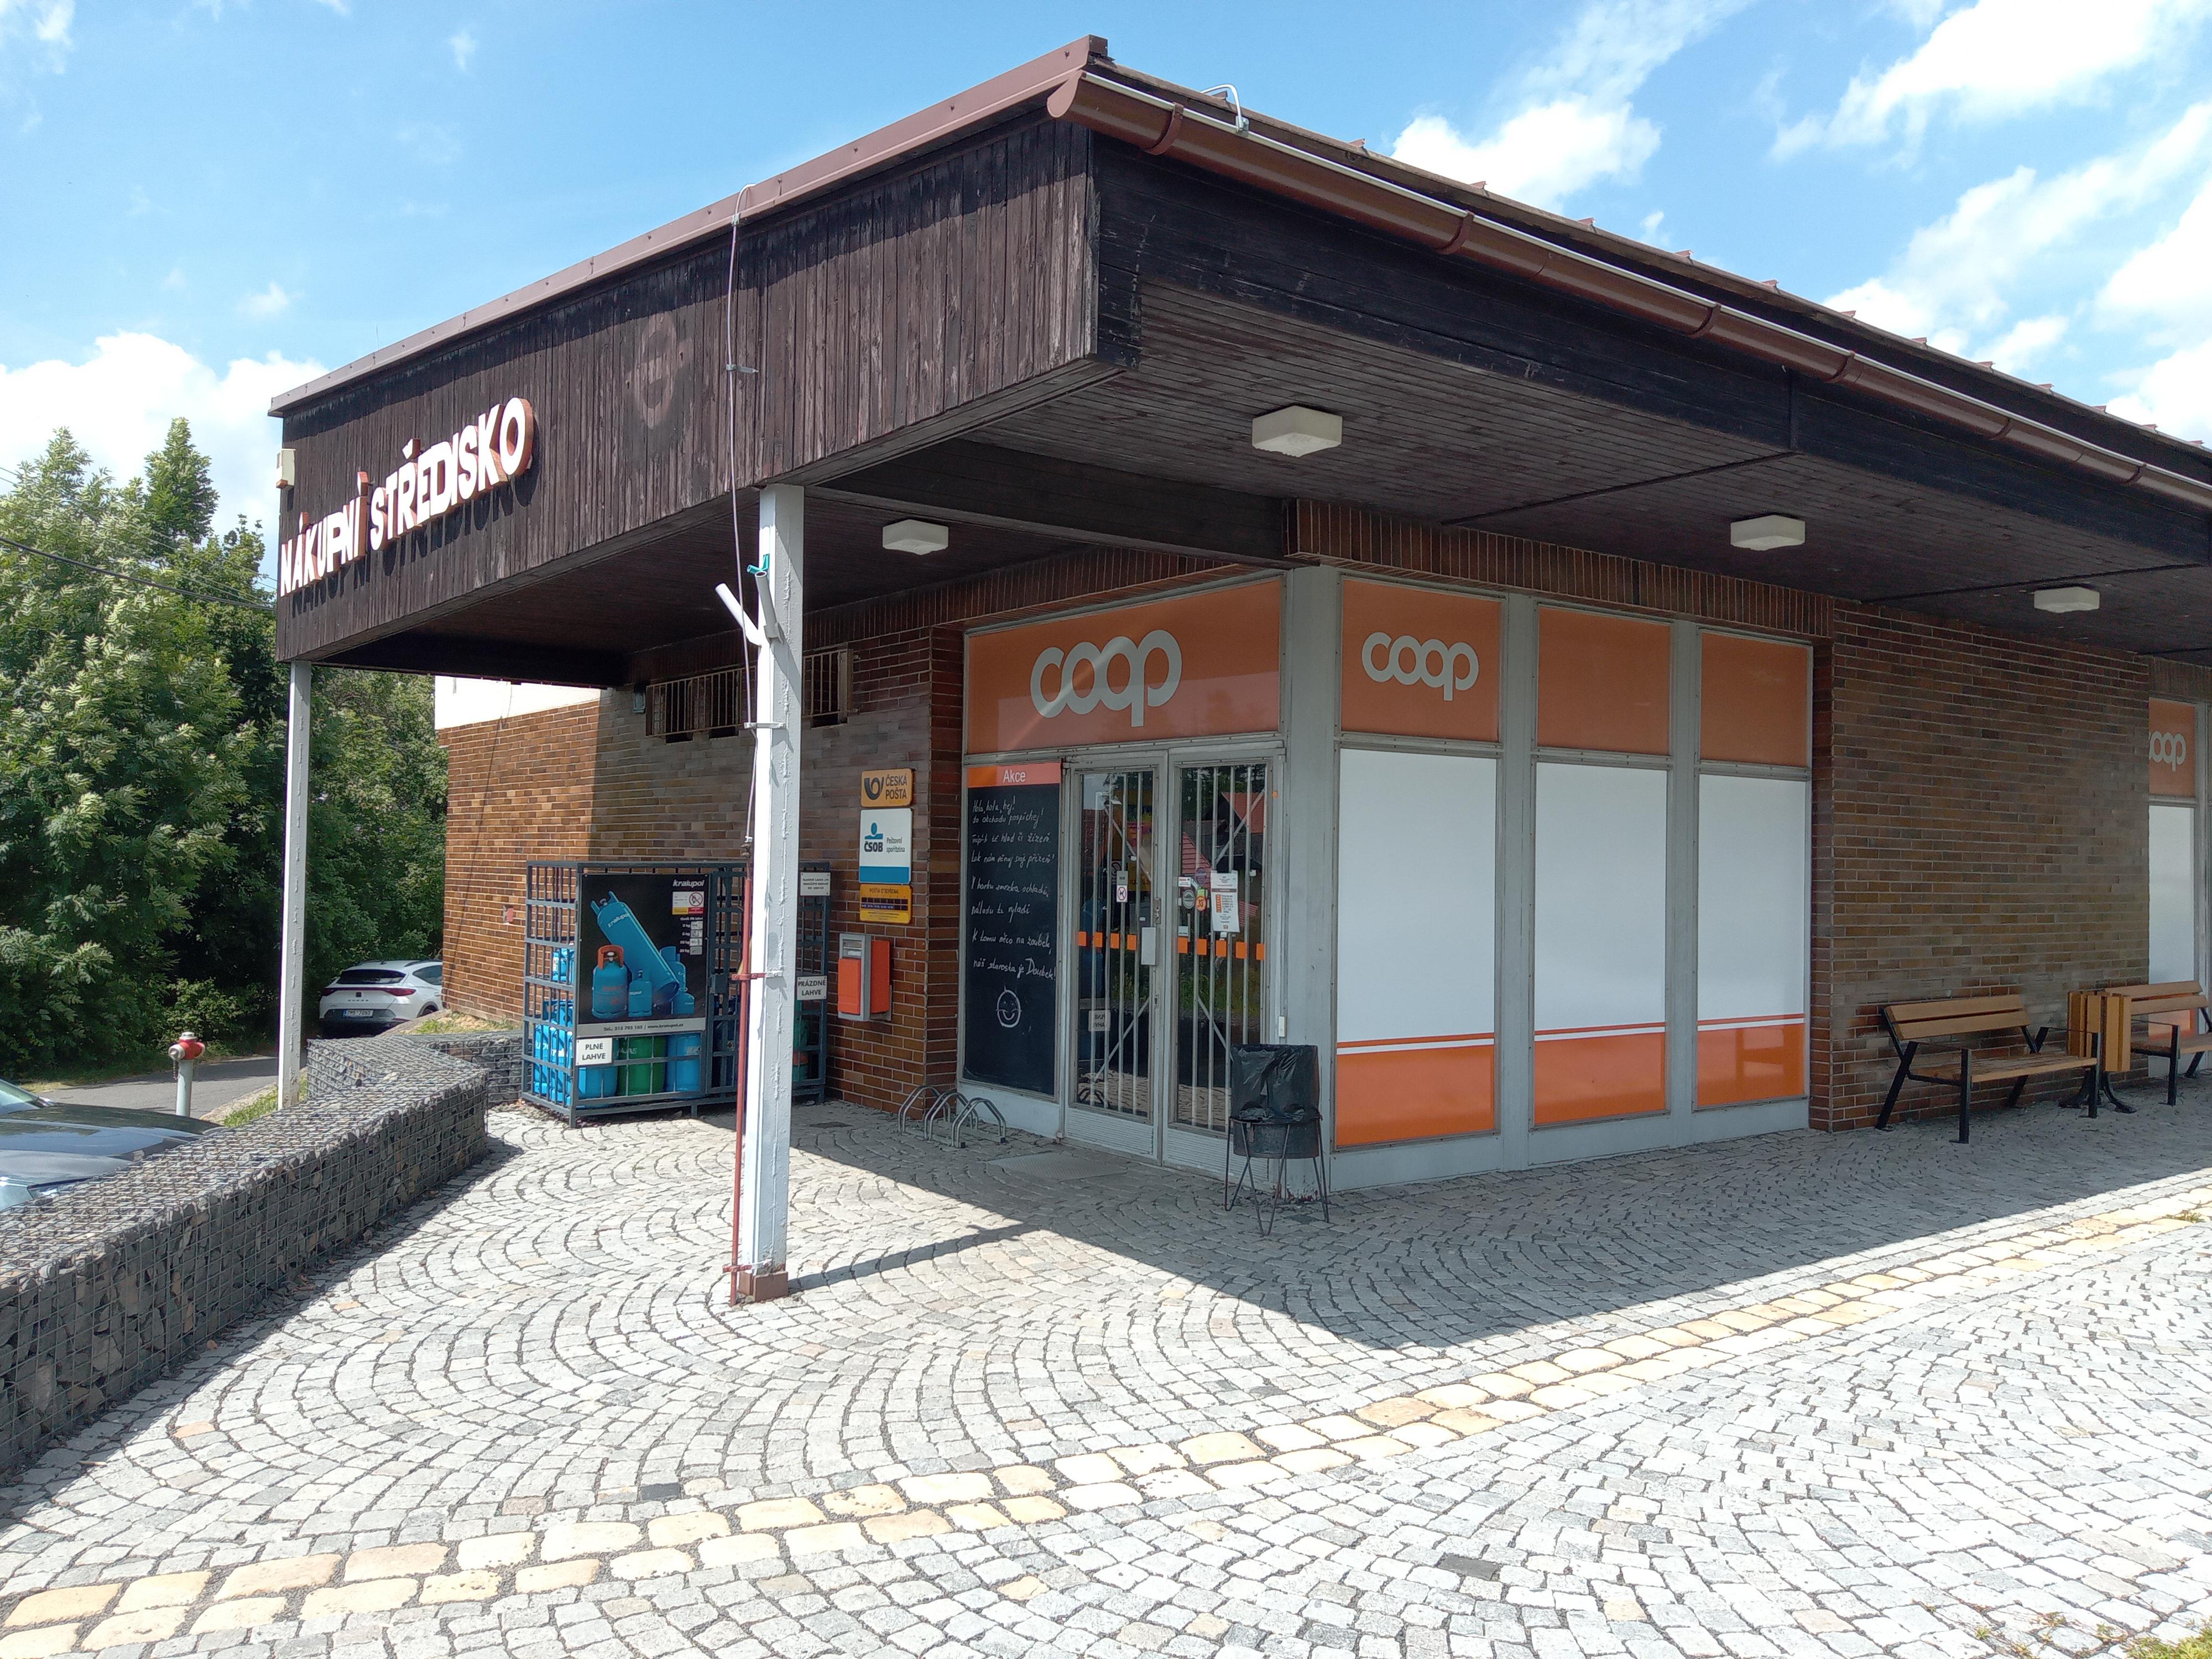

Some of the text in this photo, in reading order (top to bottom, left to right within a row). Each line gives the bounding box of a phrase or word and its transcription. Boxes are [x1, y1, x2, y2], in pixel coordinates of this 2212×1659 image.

[280, 397, 534, 597] NÁKUPNÍ STŘEDISKO
[1361, 632, 1479, 702] coop
[1030, 629, 1183, 728] coop
[2149, 731, 2187, 772] oop
[886, 774, 907, 786] ČESKÁ
[1003, 769, 1027, 784] Akce
[886, 786, 907, 800] POŠTA
[1000, 832, 1015, 843] hlad
[864, 840, 884, 852] ČSOB
[886, 846, 905, 854] spořitelna
[673, 879, 705, 888] kralupol
[971, 900, 994, 915] náladu
[972, 927, 978, 942] K
[979, 930, 997, 942] tomu
[999, 932, 1013, 945] něco
[973, 957, 1056, 981] náš starosta je Doubek!
[798, 978, 826, 987] PRÁZDNÉ
[585, 1041, 604, 1050] PLNÉ
[582, 1052, 606, 1061] LAHVE
